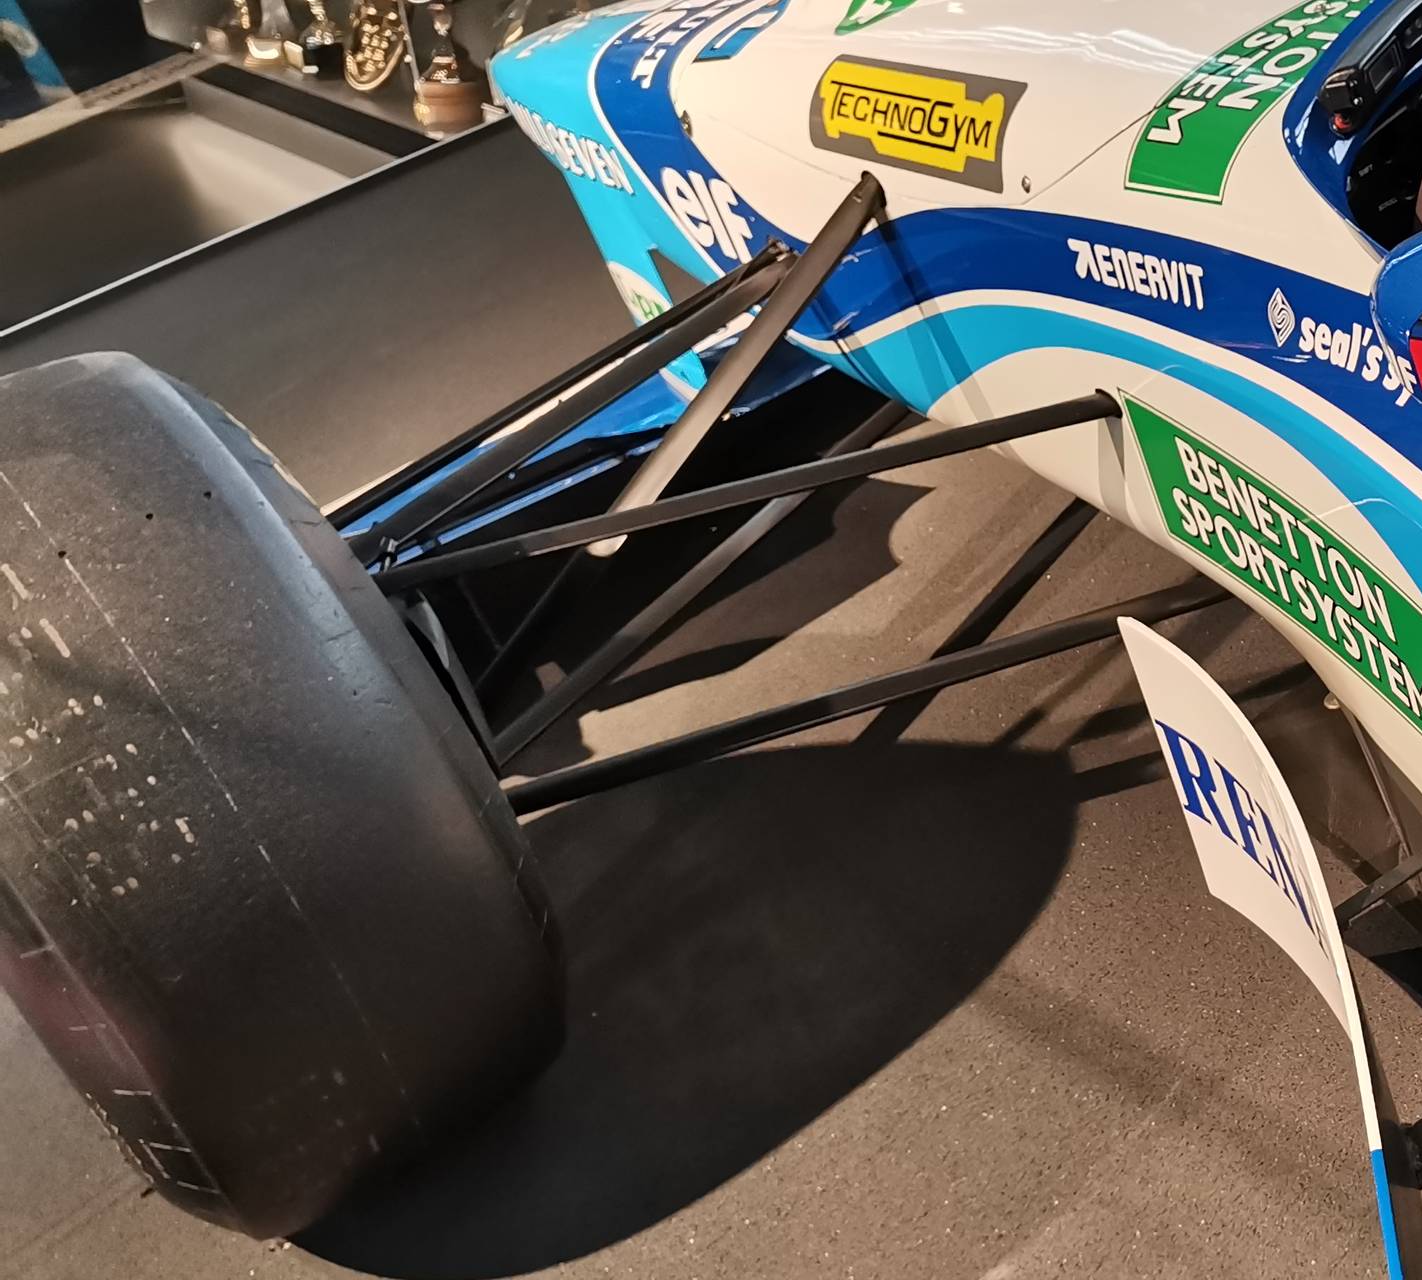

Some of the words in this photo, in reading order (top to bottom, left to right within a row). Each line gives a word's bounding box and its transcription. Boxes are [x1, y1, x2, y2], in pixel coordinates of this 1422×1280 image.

[1146, 0, 1350, 144] SYSTEM
[662, 167, 754, 265] elf
[1174, 435, 1397, 645] BENETTON
